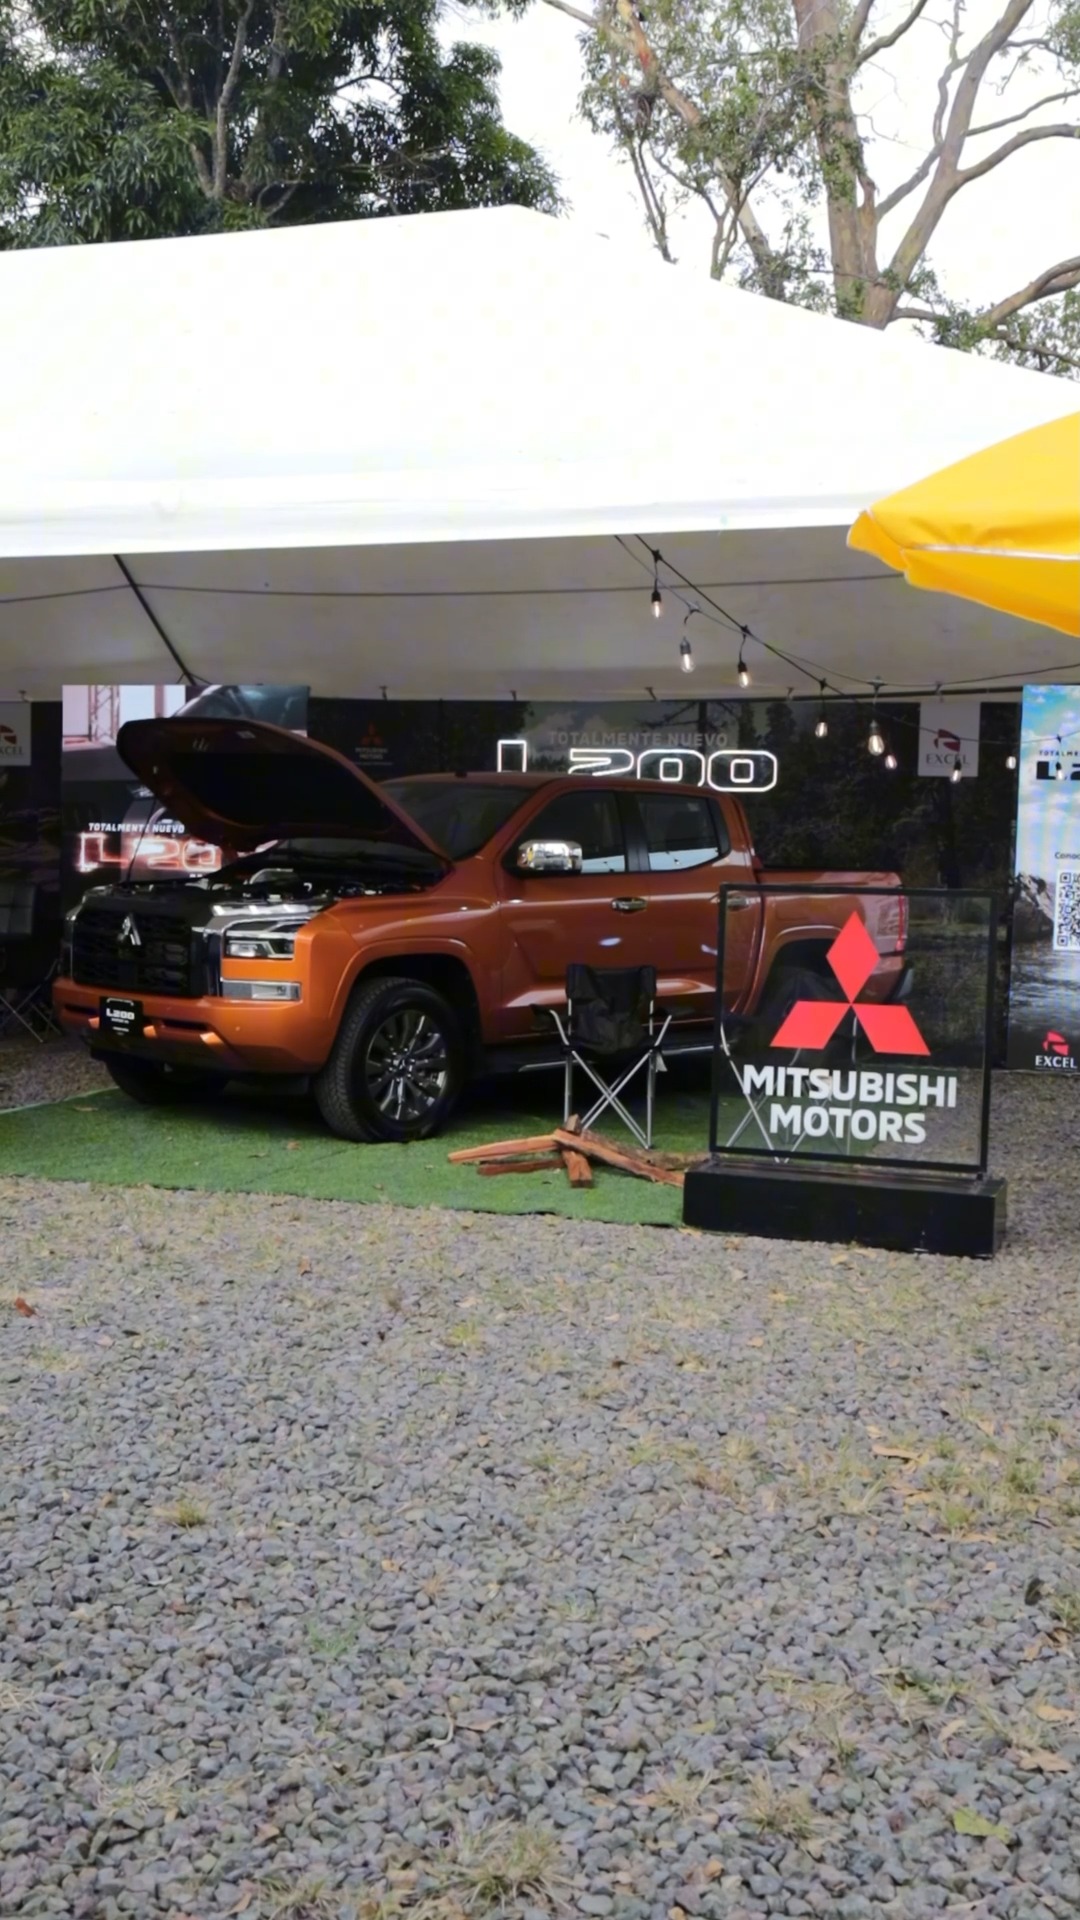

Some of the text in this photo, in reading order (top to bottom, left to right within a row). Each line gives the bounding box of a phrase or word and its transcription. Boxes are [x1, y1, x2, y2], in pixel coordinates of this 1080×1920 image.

[549, 731, 728, 748] TOTALMENTE NUEVO
[152, 823, 185, 834] NUEVO
[105, 1007, 136, 1021] L200
[1035, 1054, 1078, 1069] EXCEL
[742, 1064, 957, 1108] MITSUBISHI
[769, 1103, 927, 1144] MOTORS
